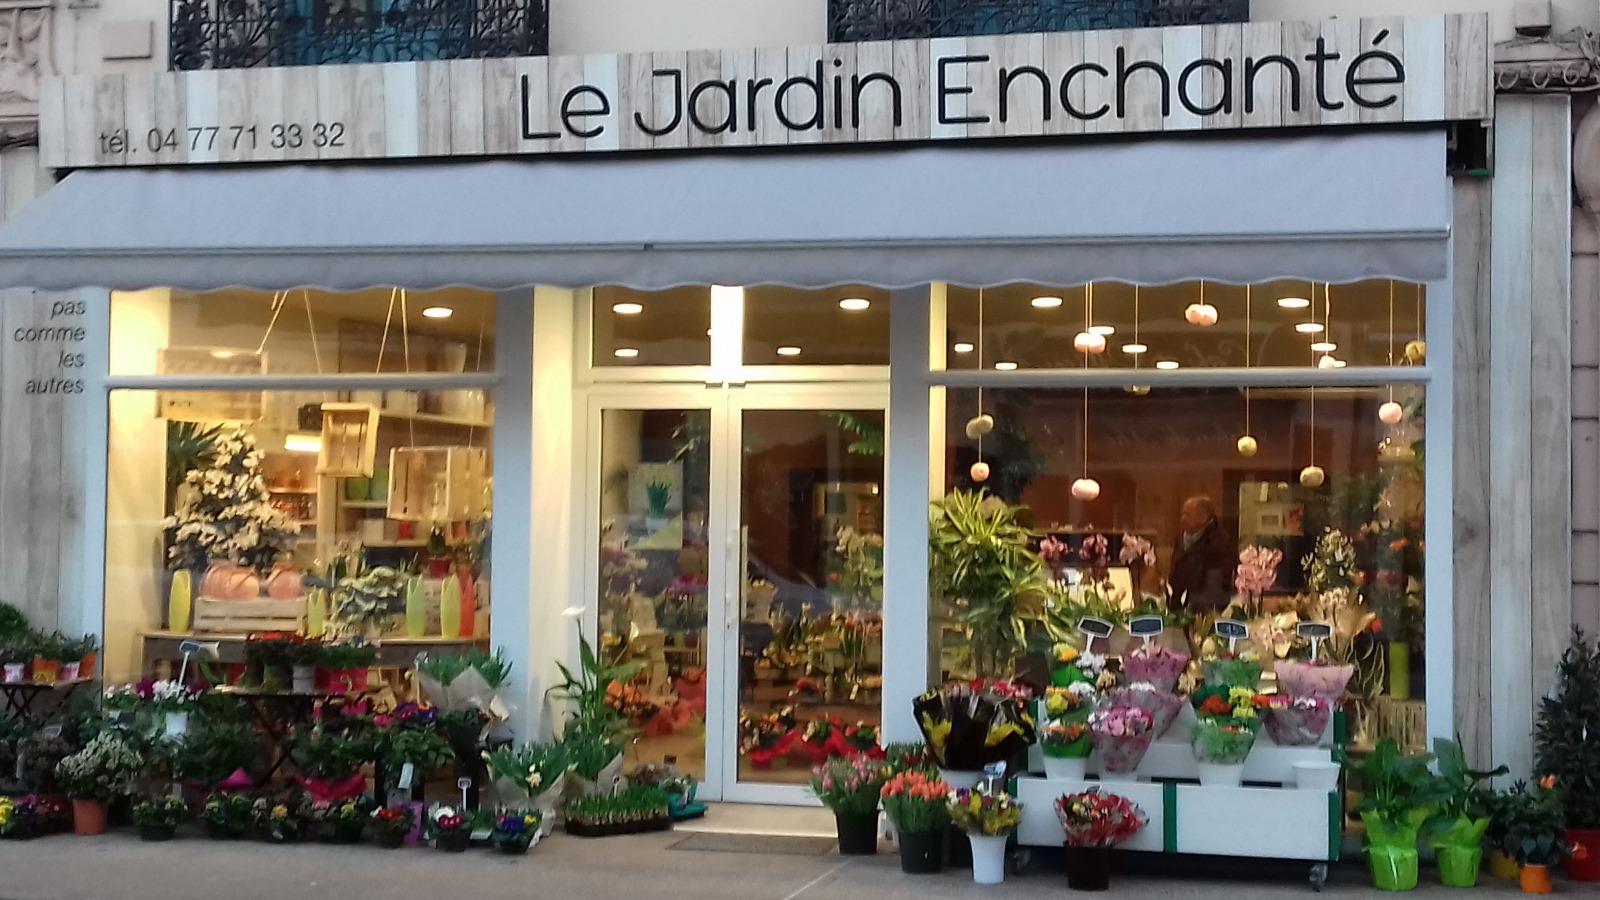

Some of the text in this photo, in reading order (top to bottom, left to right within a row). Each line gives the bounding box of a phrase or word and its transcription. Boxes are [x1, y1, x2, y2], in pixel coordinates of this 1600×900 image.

[522, 29, 1405, 140] Le Jardin Enchanté
[98, 122, 345, 154] tél. 04 77 71 33 32
[50, 300, 87, 321] pas
[13, 327, 86, 343] comme
[58, 349, 86, 369] les
[25, 376, 86, 395] autres
